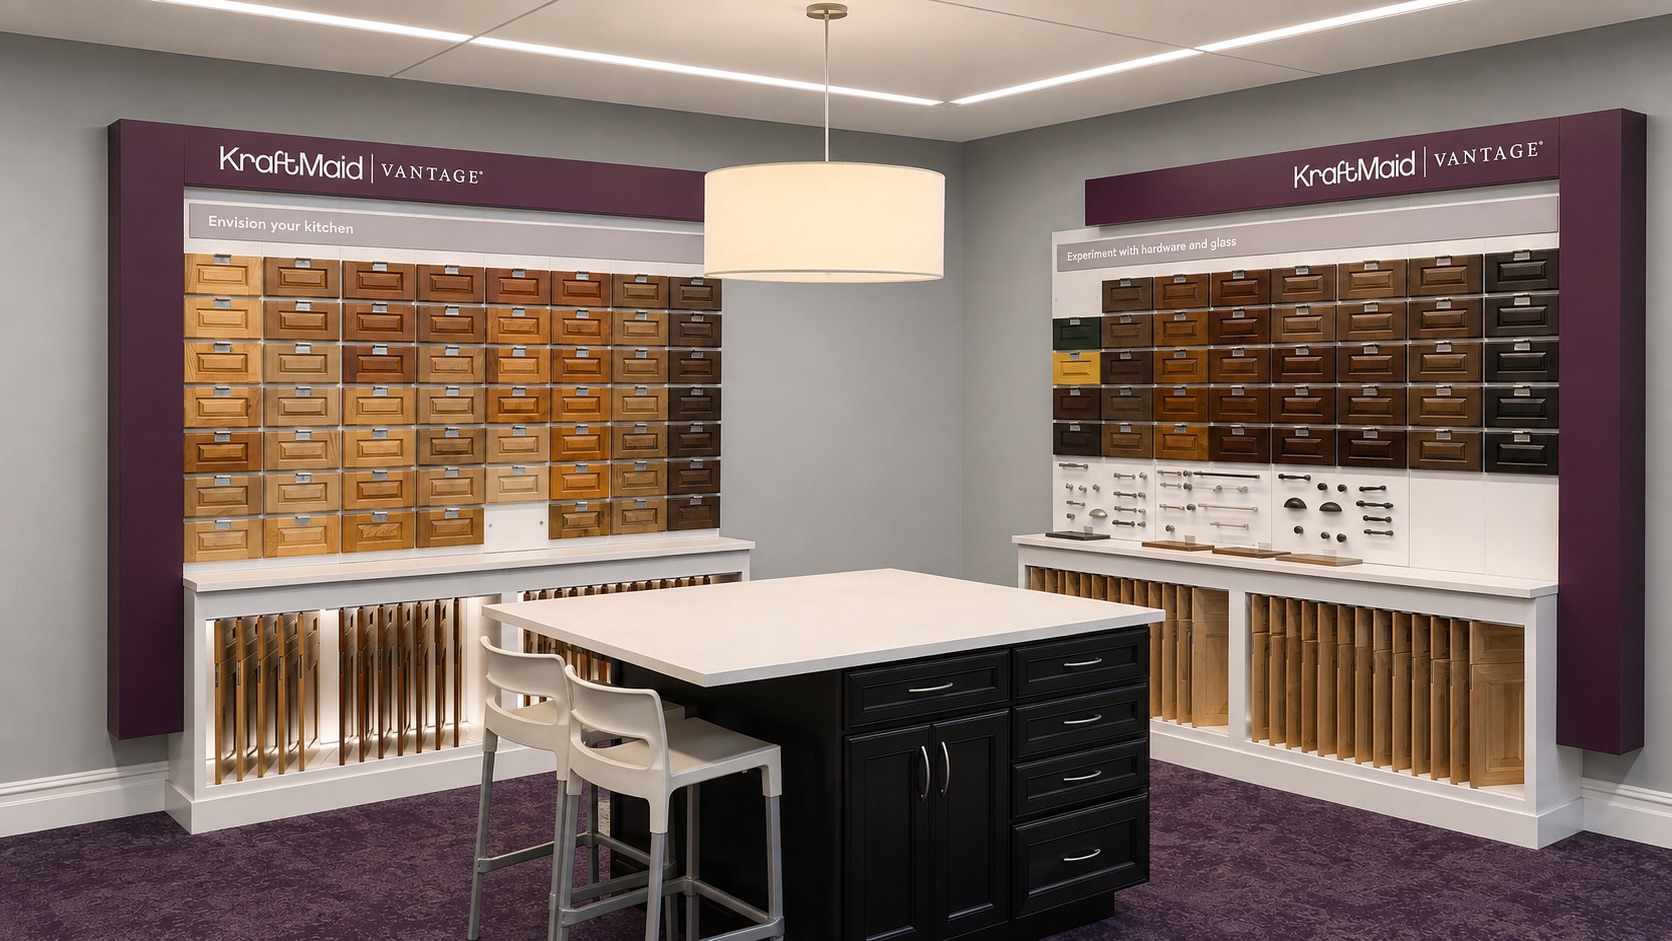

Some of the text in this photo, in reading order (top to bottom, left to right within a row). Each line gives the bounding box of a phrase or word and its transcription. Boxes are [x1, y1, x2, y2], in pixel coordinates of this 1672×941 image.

[219, 145, 363, 180] KraftMaid
[1294, 149, 1416, 189] KraftMaid
[208, 215, 354, 235] Envision your kitchen
[1067, 236, 1238, 263] Experiment with hardware and glass
